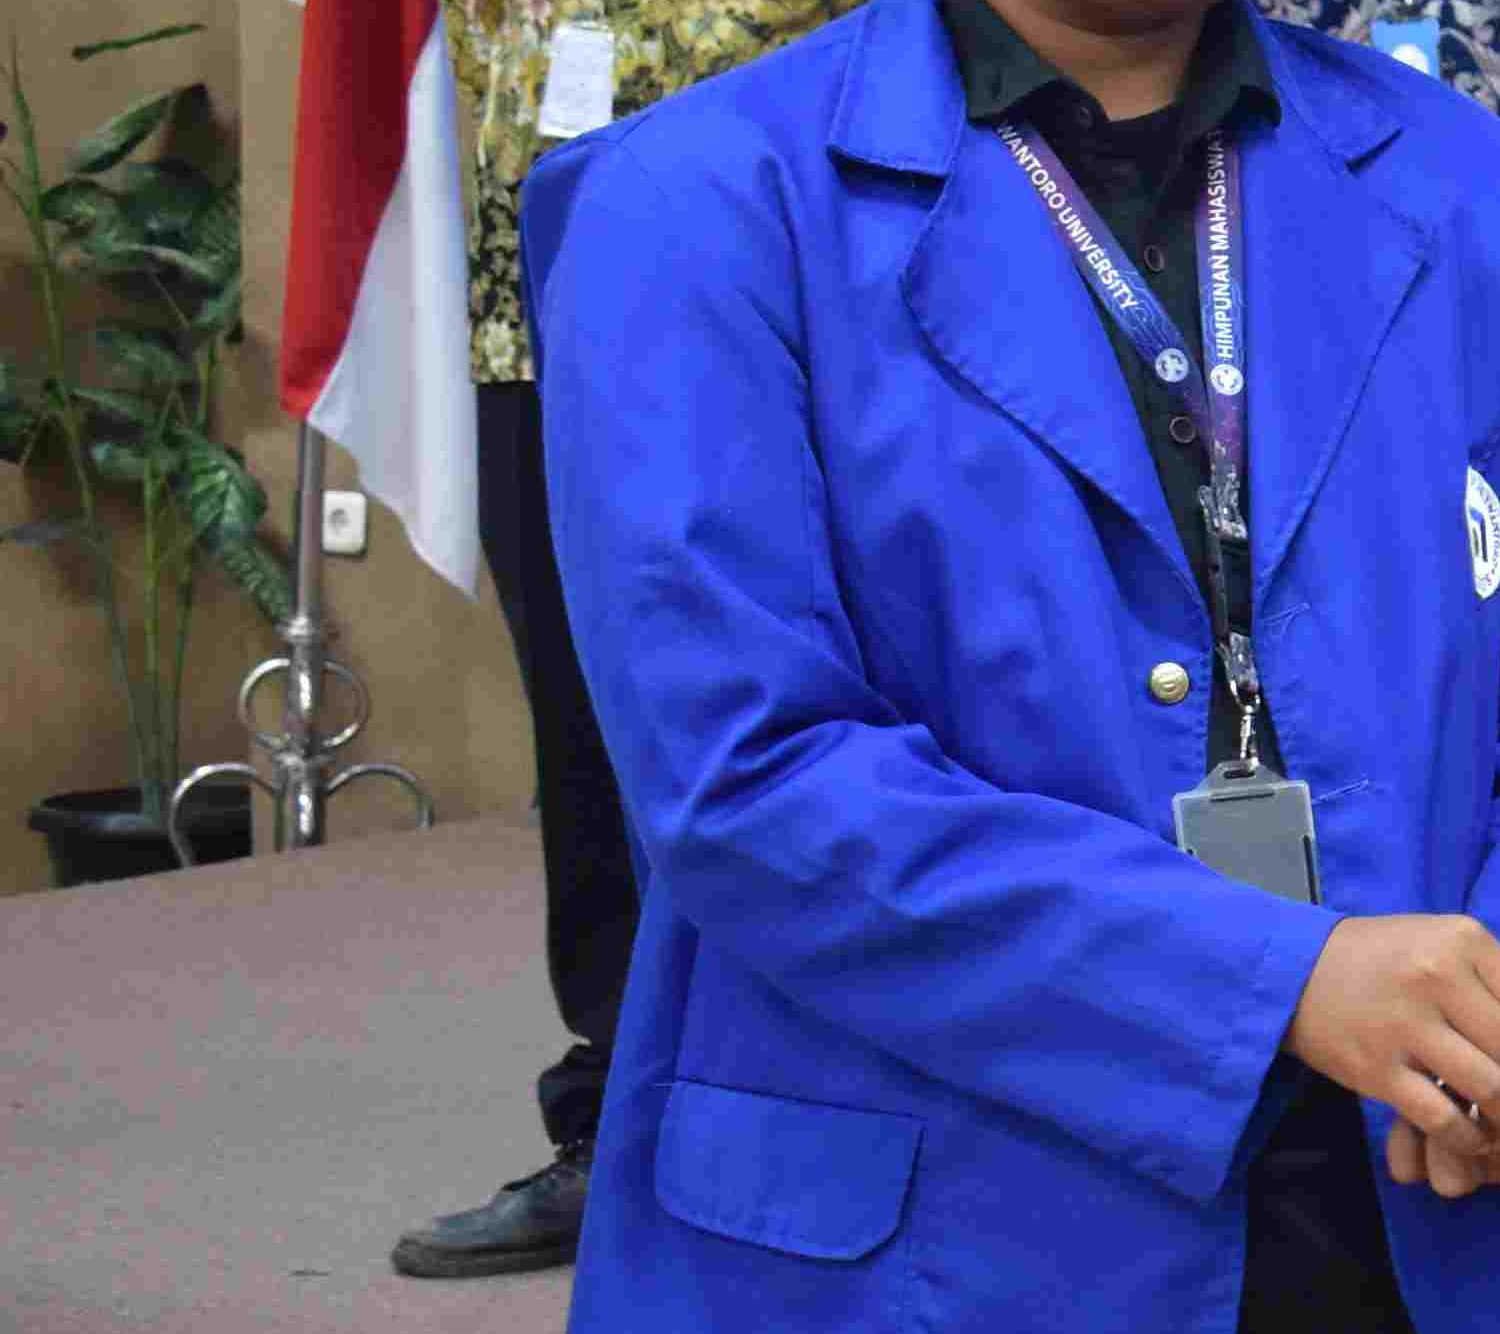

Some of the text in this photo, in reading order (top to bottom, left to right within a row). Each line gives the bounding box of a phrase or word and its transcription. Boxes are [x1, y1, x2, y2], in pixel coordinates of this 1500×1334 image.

[997, 124, 1139, 310] WANTORO UNIVERSITY
[1213, 254, 1234, 359] HIMPUNAN
